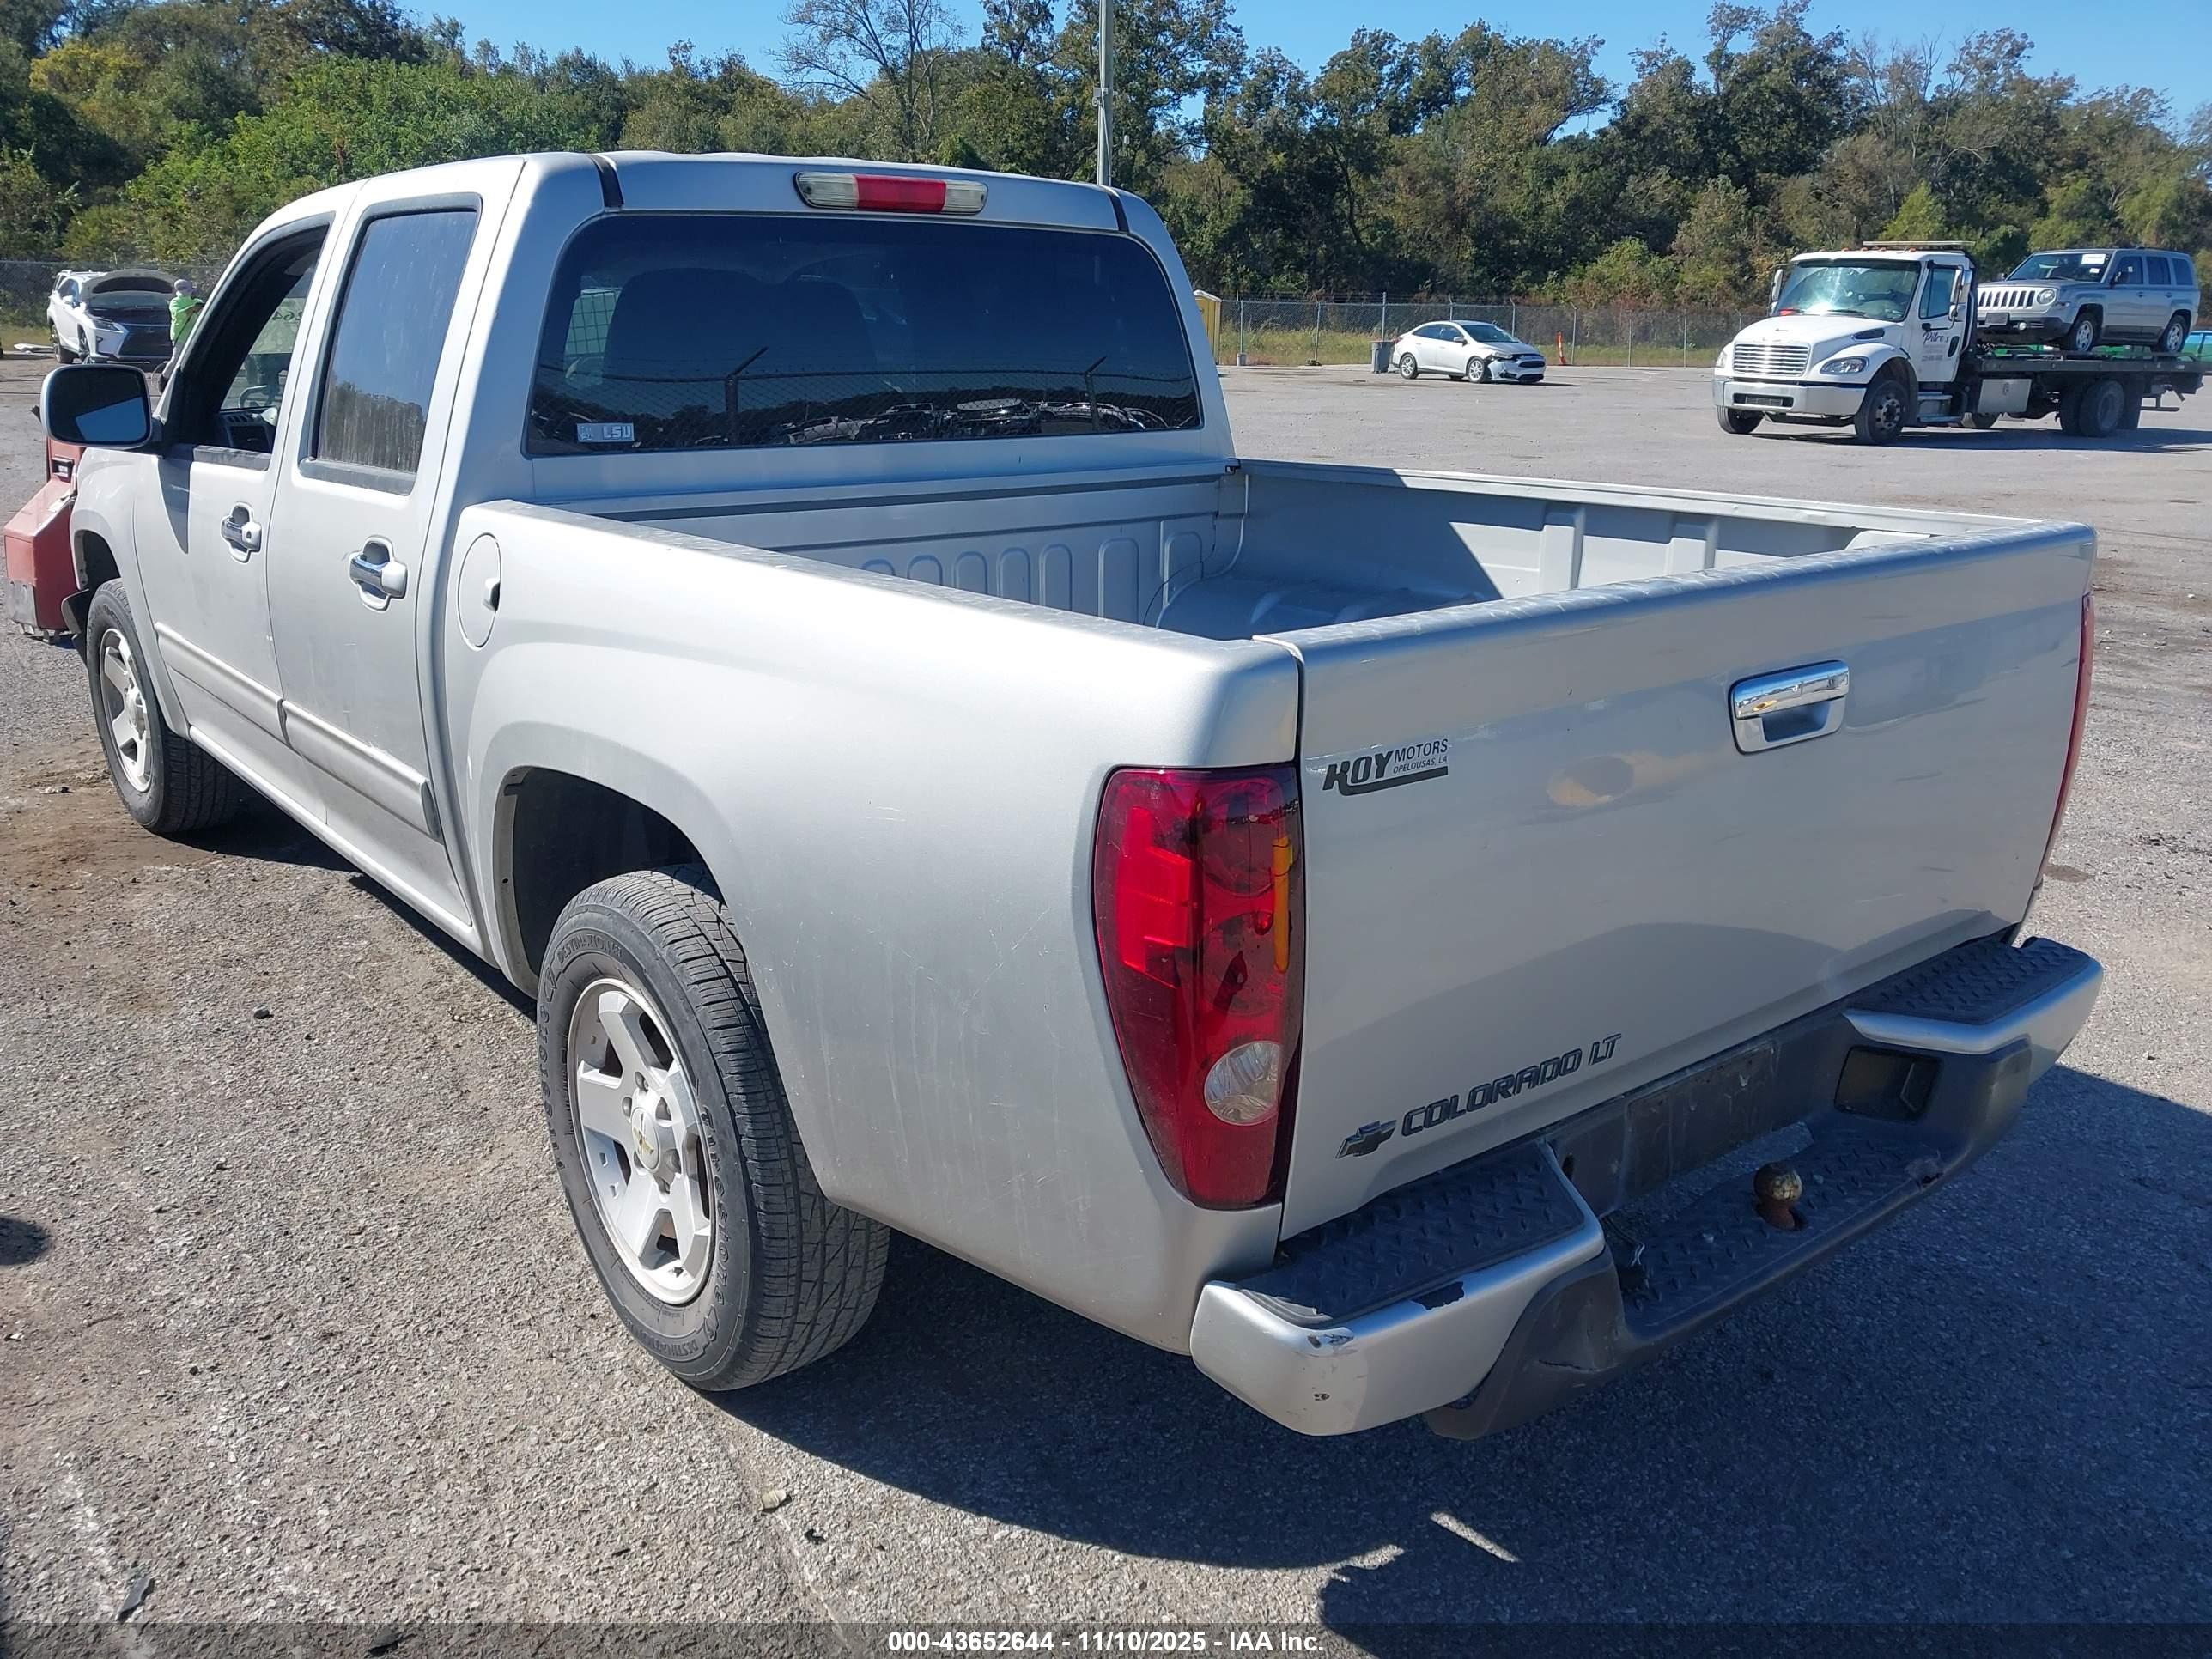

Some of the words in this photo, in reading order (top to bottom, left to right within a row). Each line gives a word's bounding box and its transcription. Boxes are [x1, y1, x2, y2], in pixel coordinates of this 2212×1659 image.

[603, 425, 631, 440] LSU
[1394, 738, 1449, 763] MOTORS
[1438, 755, 1448, 764] LA
[1401, 1048, 1583, 1136] COLORADO
[1589, 1033, 1621, 1065] LT
